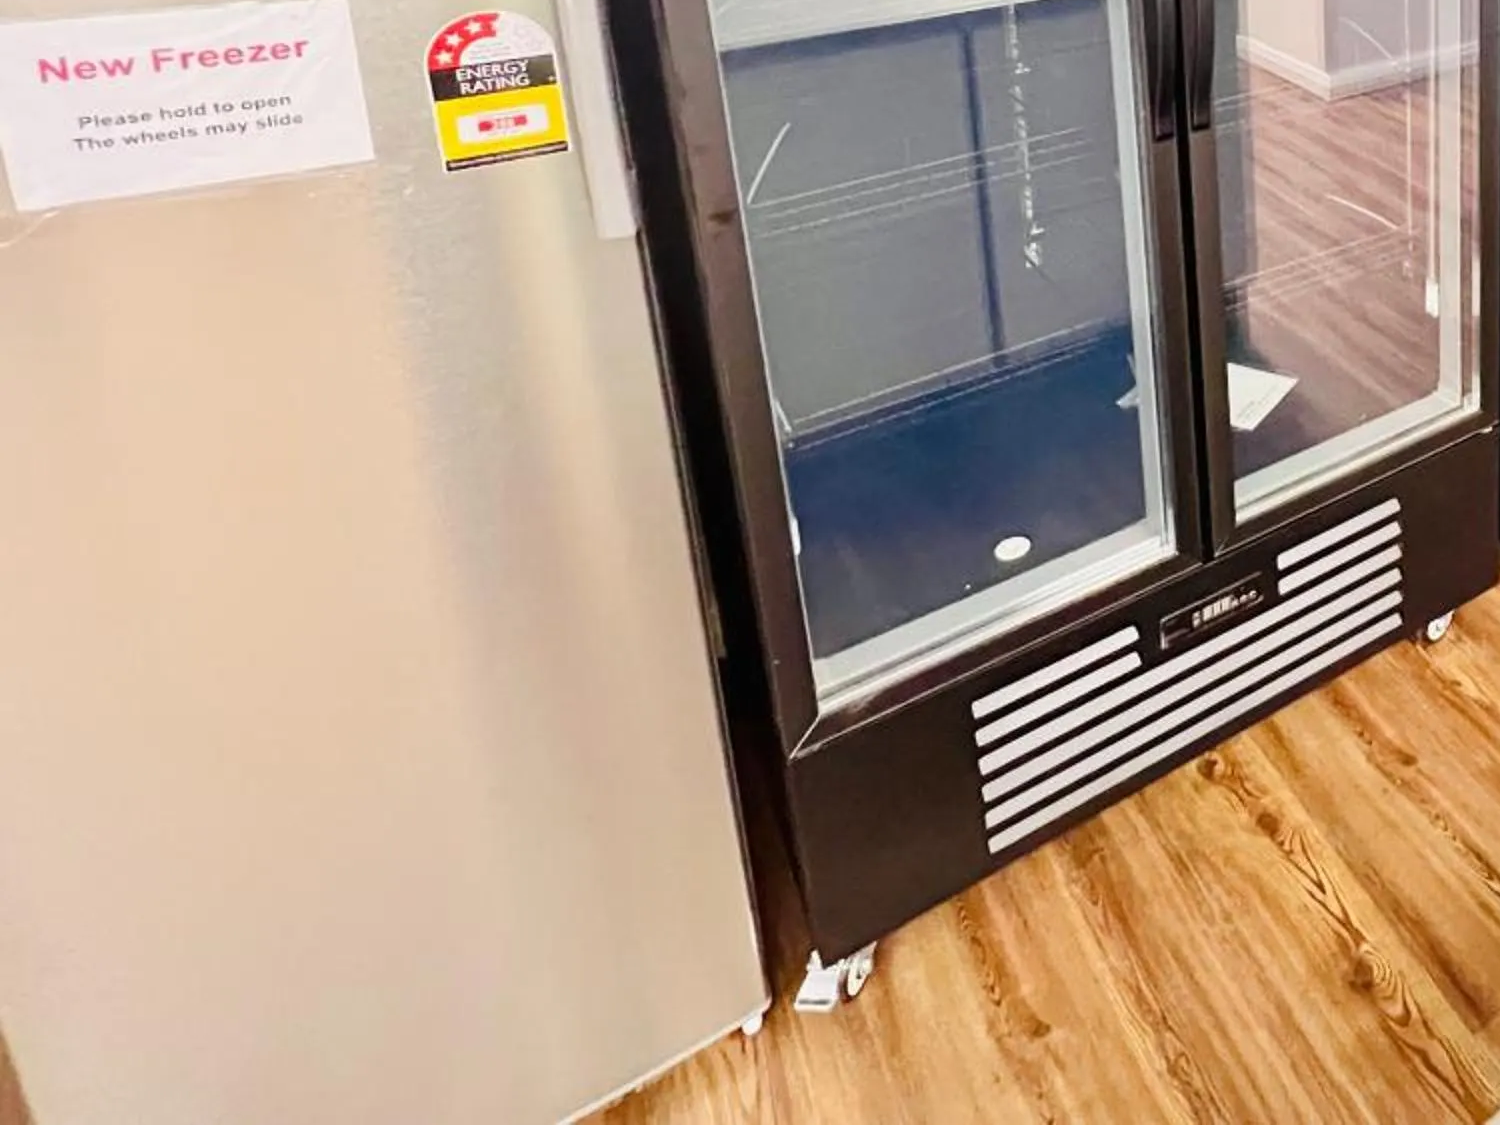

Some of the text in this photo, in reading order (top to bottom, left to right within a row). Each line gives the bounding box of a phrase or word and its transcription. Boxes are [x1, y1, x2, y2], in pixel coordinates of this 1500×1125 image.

[37, 40, 310, 84] New Freezer
[455, 59, 529, 82] ENERGY
[460, 74, 531, 95] RATING
[78, 94, 292, 130] Please hold to open
[72, 113, 304, 152] The wheels may slide
